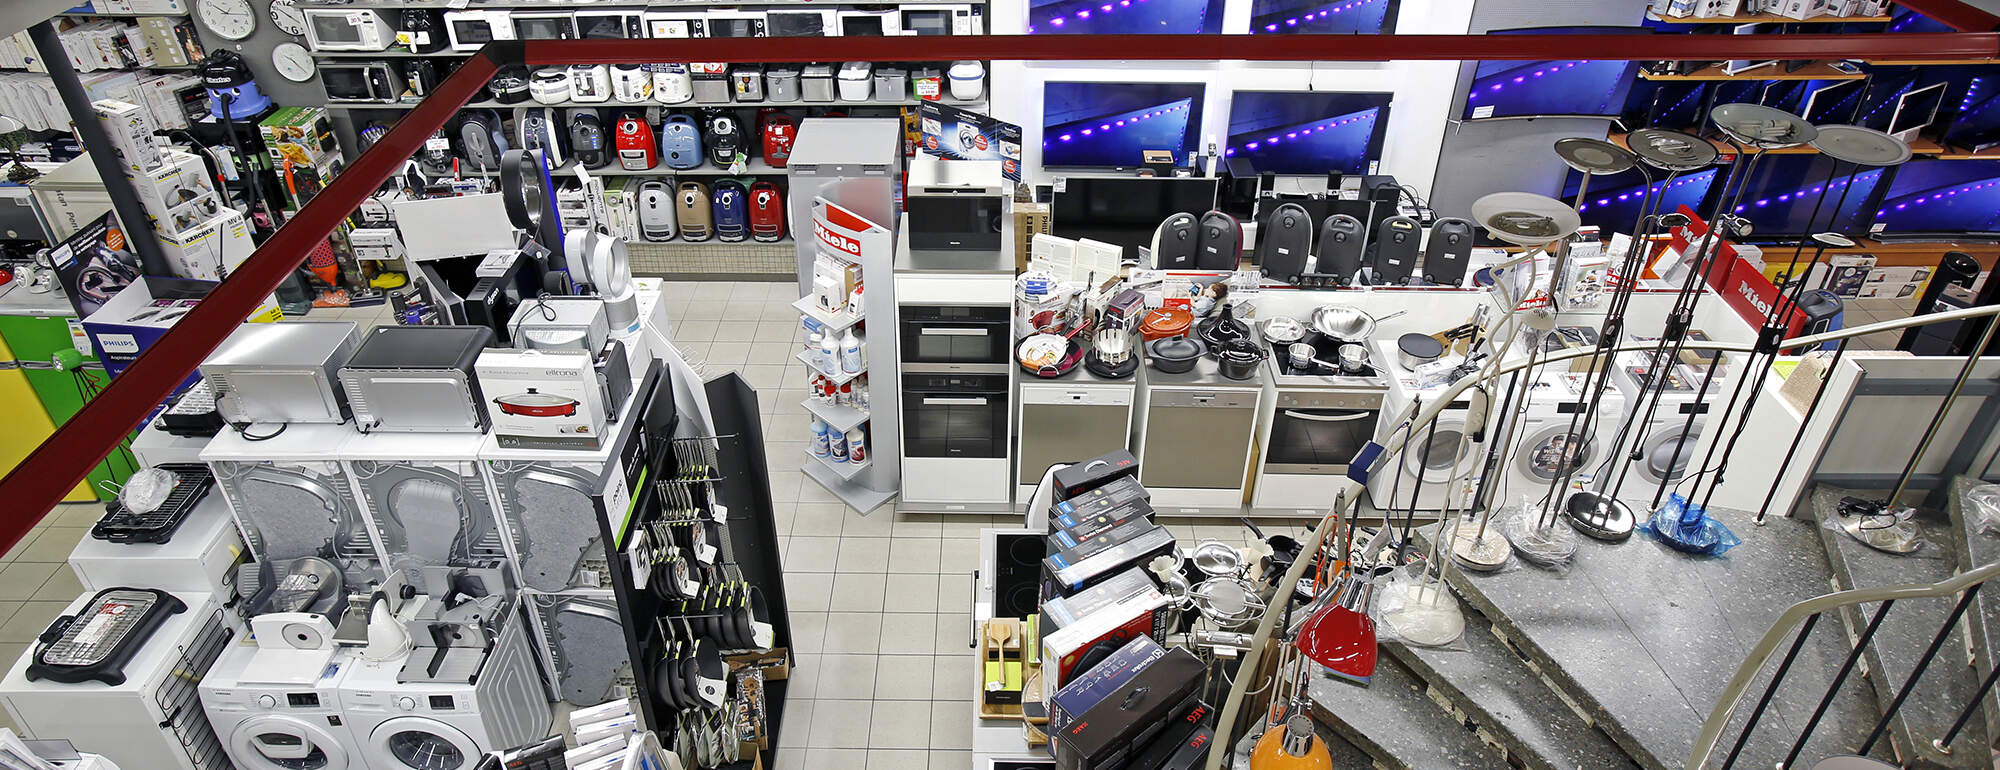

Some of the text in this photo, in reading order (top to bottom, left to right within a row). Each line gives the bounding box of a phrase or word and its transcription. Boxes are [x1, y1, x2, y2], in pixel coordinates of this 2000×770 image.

[292, 26, 299, 34] 6
[814, 220, 859, 253] Miele
[1186, 706, 1206, 724] AEG
[1190, 733, 1208, 749] AEG
